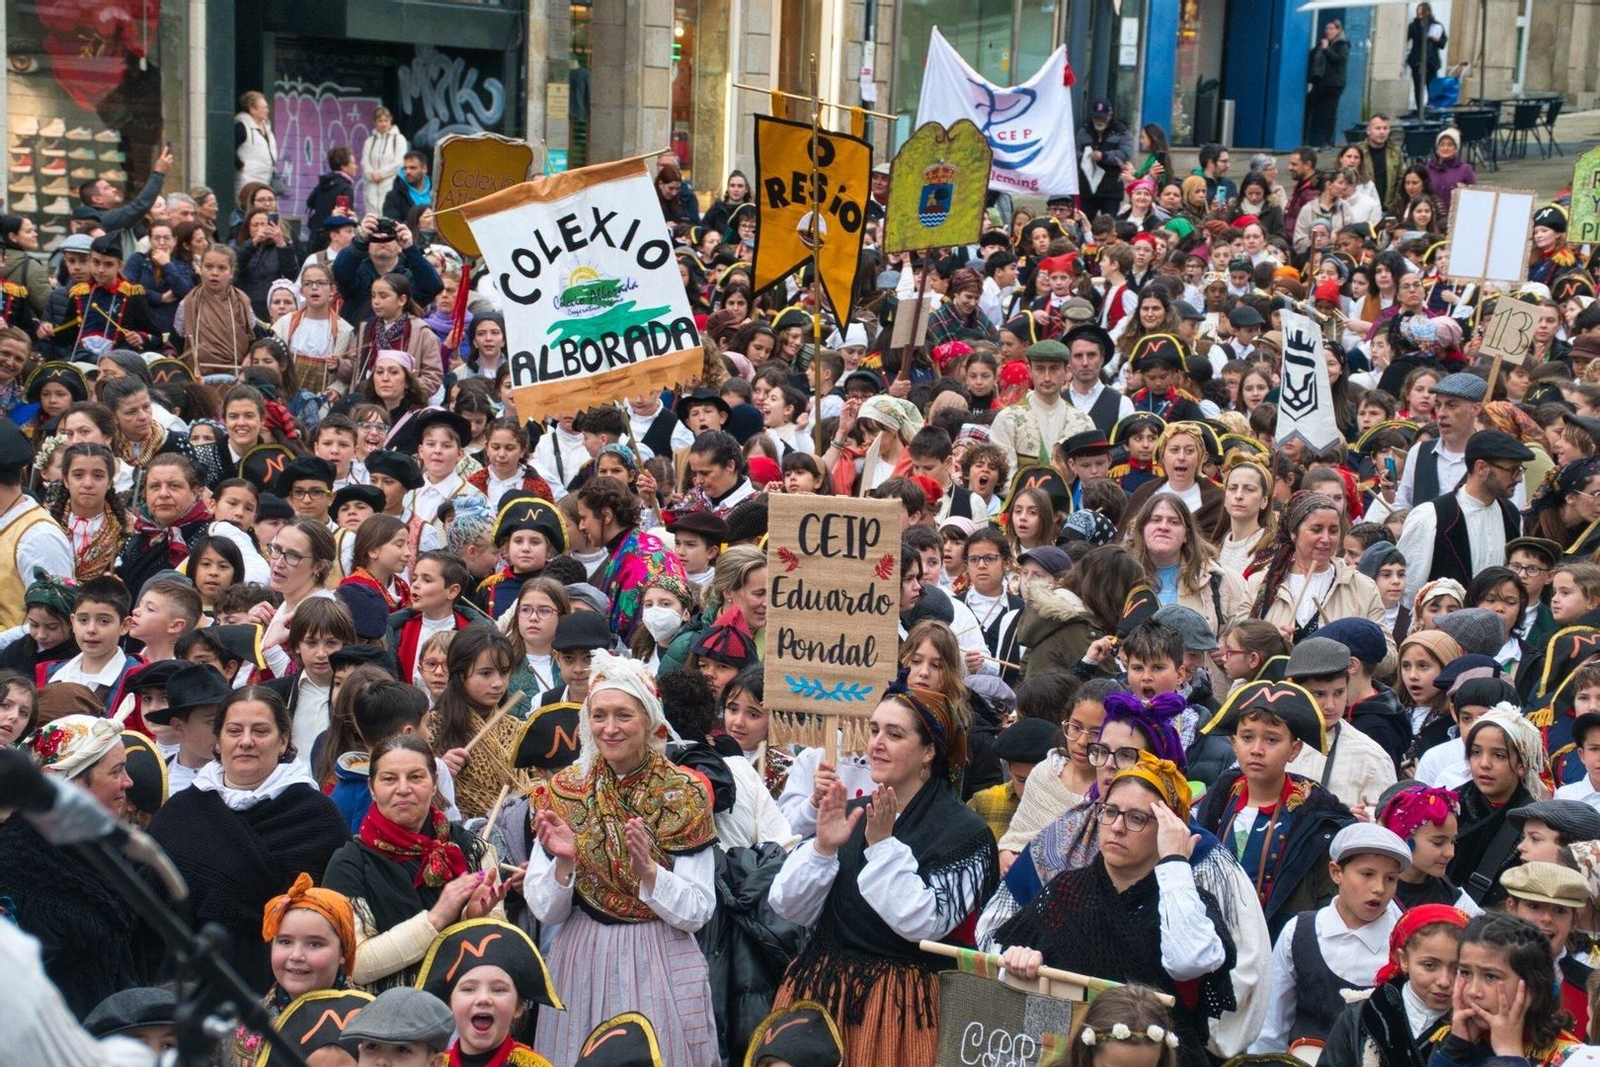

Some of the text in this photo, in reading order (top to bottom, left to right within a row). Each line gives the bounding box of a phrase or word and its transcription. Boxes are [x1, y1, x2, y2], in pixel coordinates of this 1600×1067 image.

[997, 128, 1032, 140] CEP
[807, 136, 835, 167] O
[991, 170, 1038, 191] leming
[1536, 209, 1552, 220] N
[500, 207, 670, 305] COLEXIO
[1560, 283, 1580, 298] N
[1486, 307, 1533, 355] 13
[511, 317, 701, 387] ALBORADA
[1141, 341, 1167, 358] N
[47, 369, 66, 378] N
[153, 370, 180, 383] N
[263, 454, 284, 482] N
[521, 508, 543, 521] N
[798, 513, 881, 560] CEIP
[771, 575, 893, 616] Eduardo
[778, 627, 878, 668] Pondal
[1240, 688, 1296, 710] N
[545, 725, 580, 758] N
[446, 934, 501, 982] N
